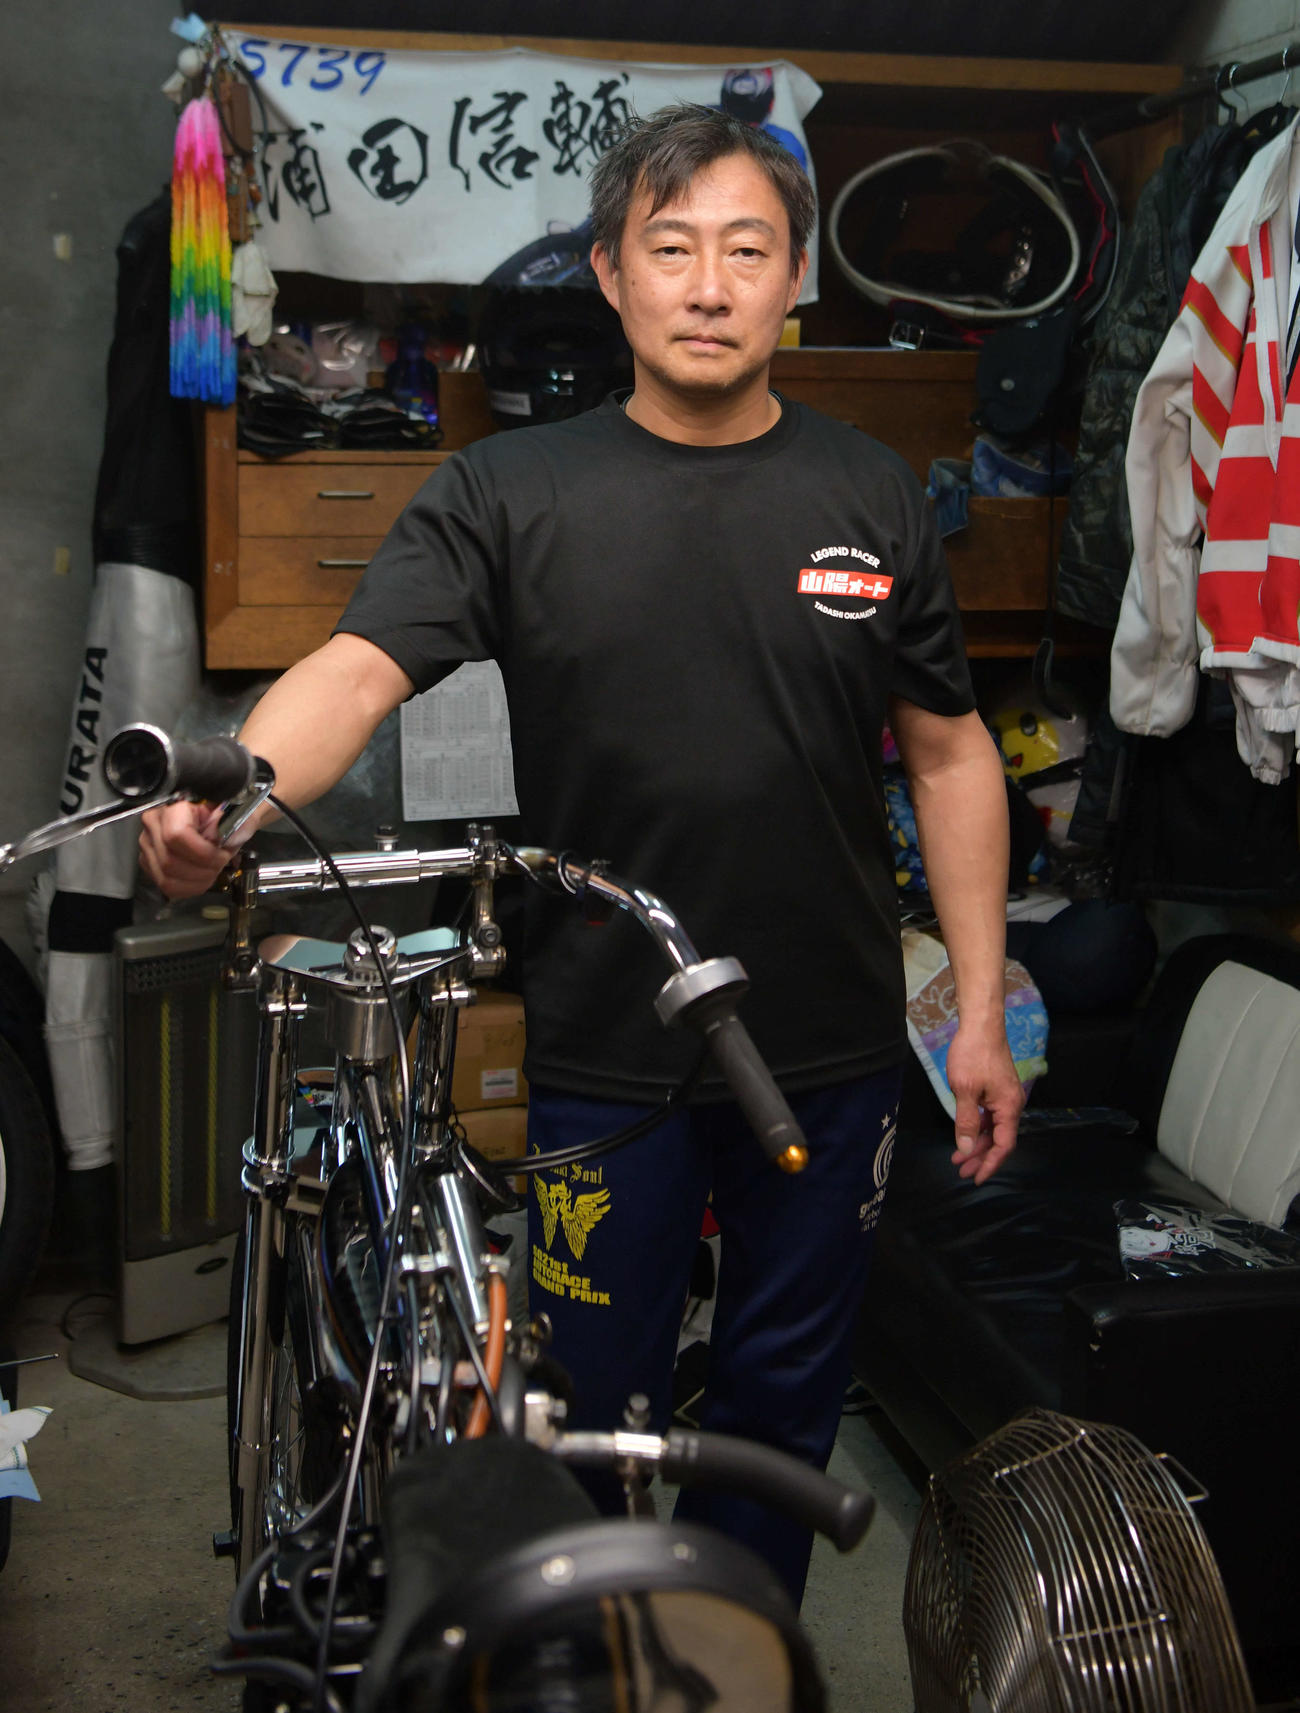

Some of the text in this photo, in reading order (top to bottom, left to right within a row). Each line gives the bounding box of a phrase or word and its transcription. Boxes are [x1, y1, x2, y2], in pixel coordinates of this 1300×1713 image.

[810, 546, 881, 568] LEGEND RACER
[800, 571, 889, 597] 山陽オート
[814, 601, 844, 619] TADASHI
[60, 647, 108, 815] URATA
[569, 1287, 611, 1306] PRIX
